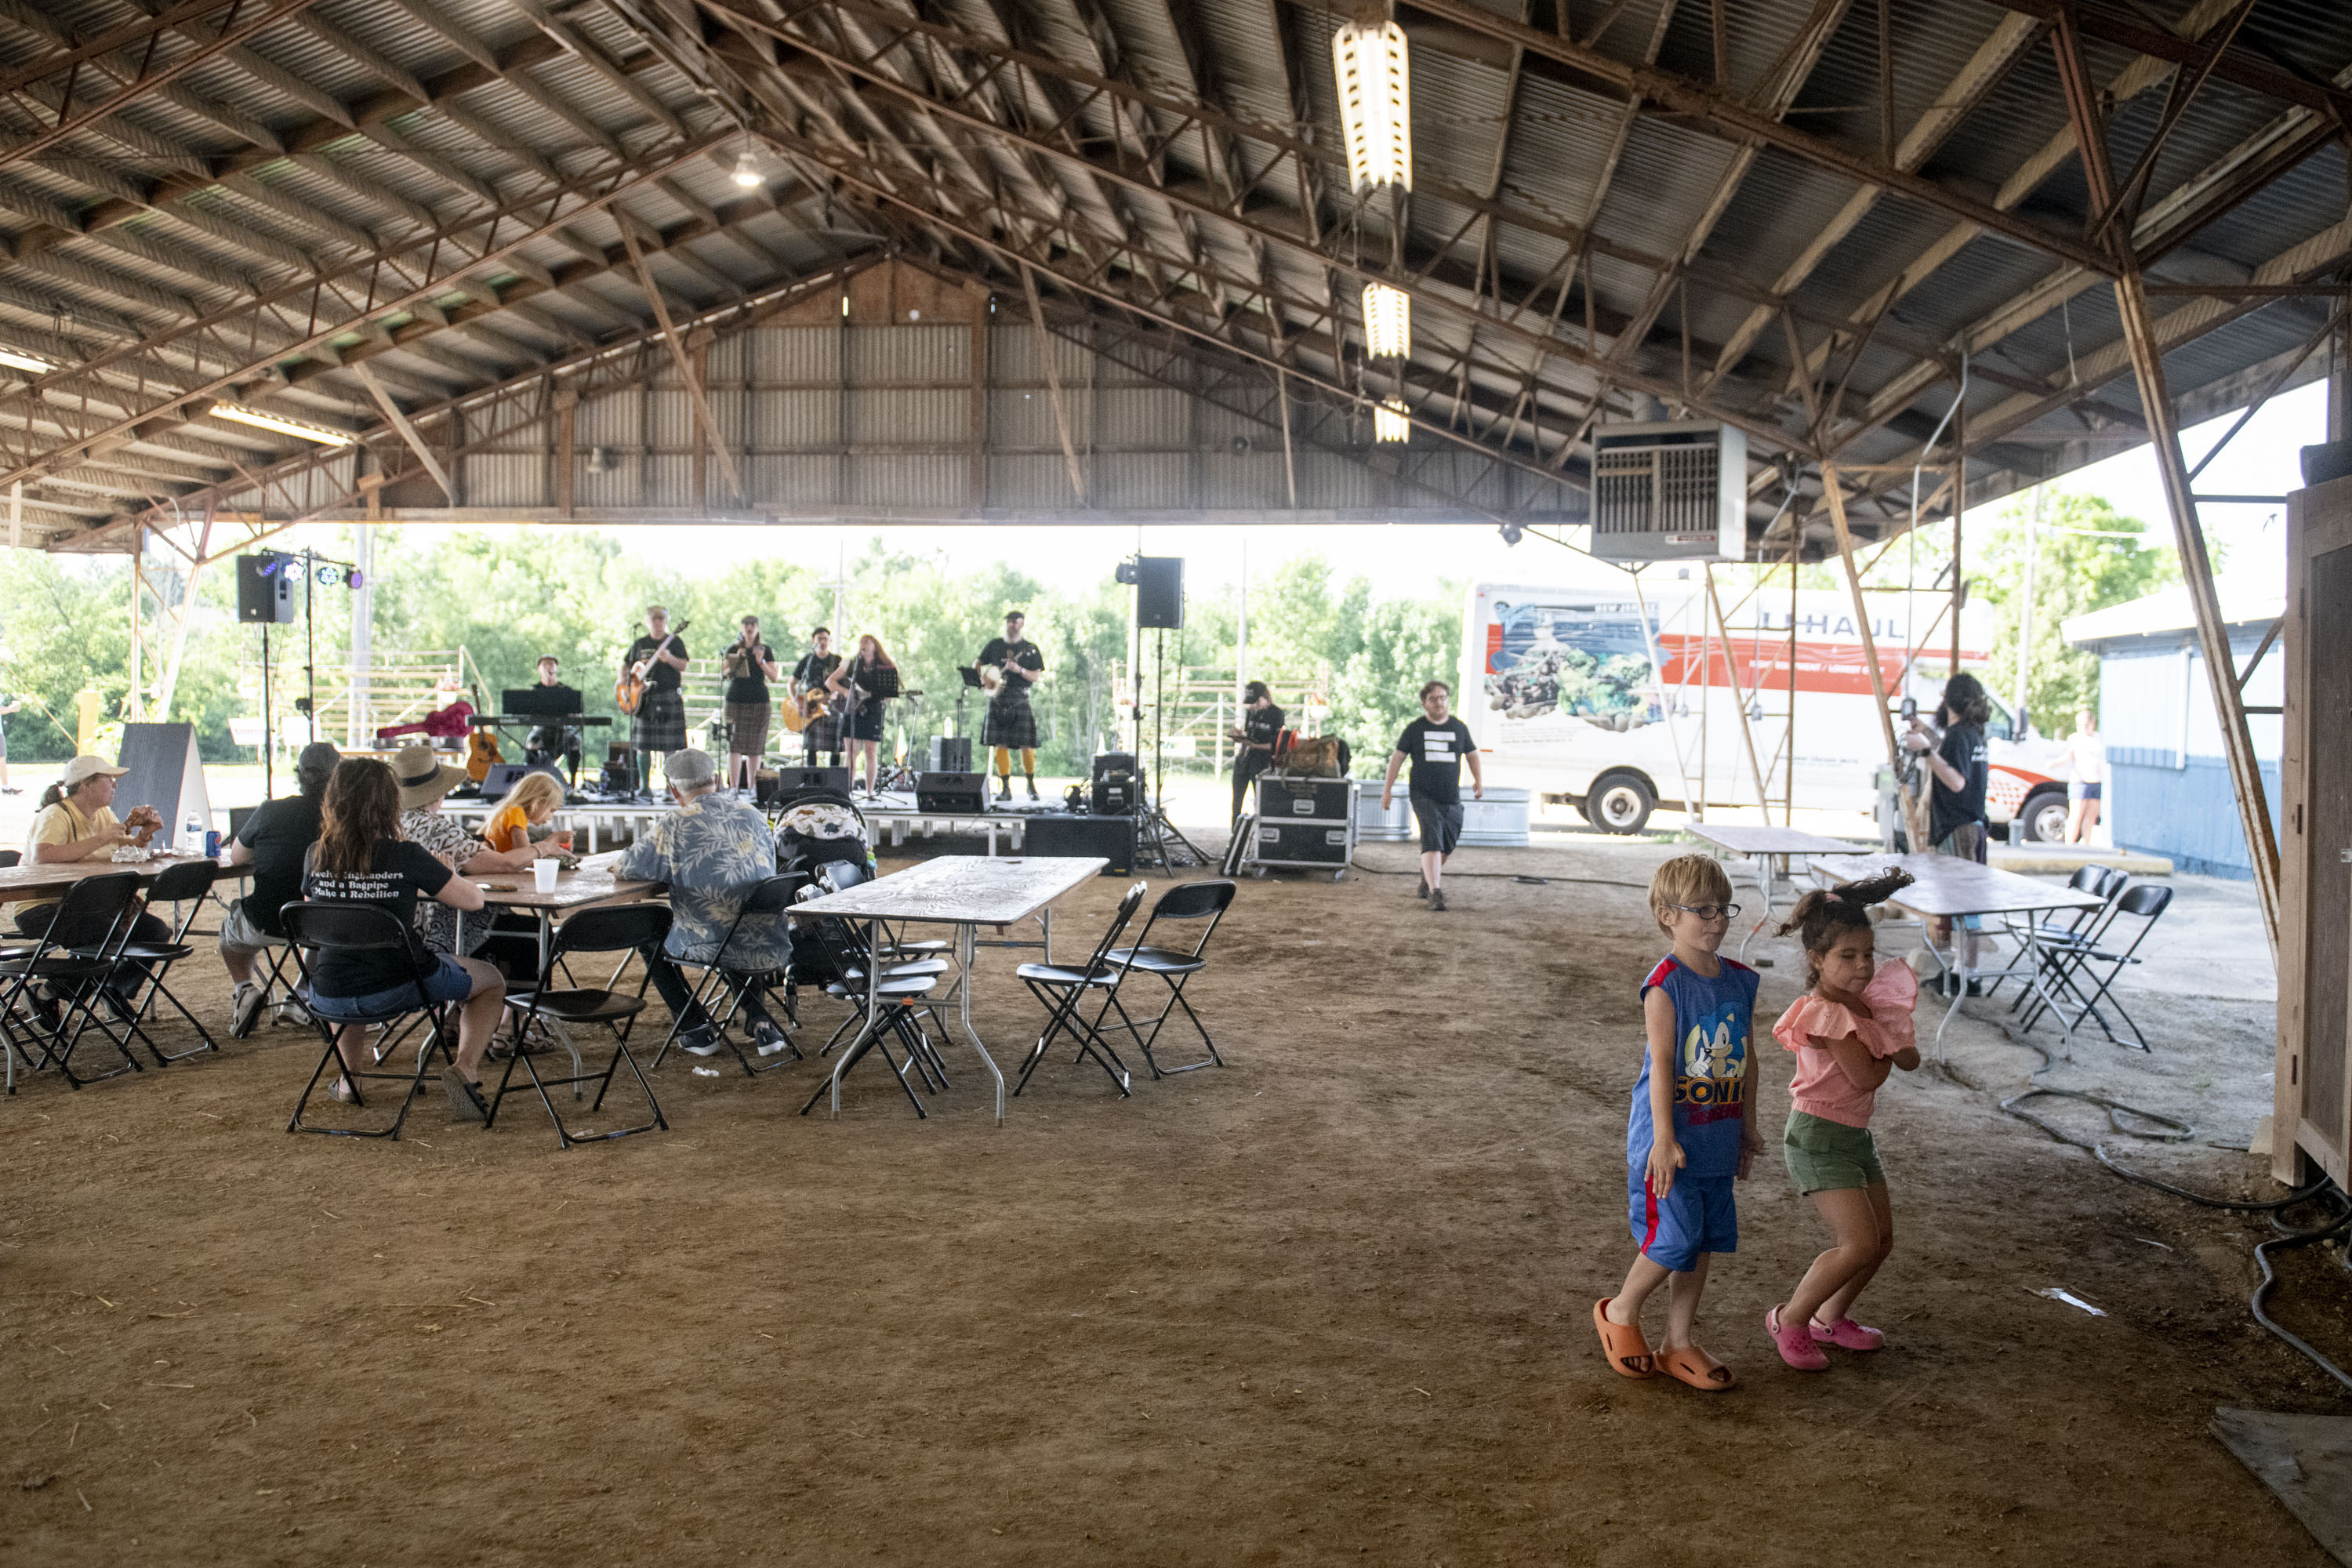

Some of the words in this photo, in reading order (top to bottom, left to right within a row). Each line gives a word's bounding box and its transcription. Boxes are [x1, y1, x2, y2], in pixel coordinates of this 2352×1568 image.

[349, 881, 389, 891] Bagpipe
[314, 887, 337, 898] Make
[350, 890, 400, 899] Rebellion
[1675, 1076, 1744, 1105] SONI
